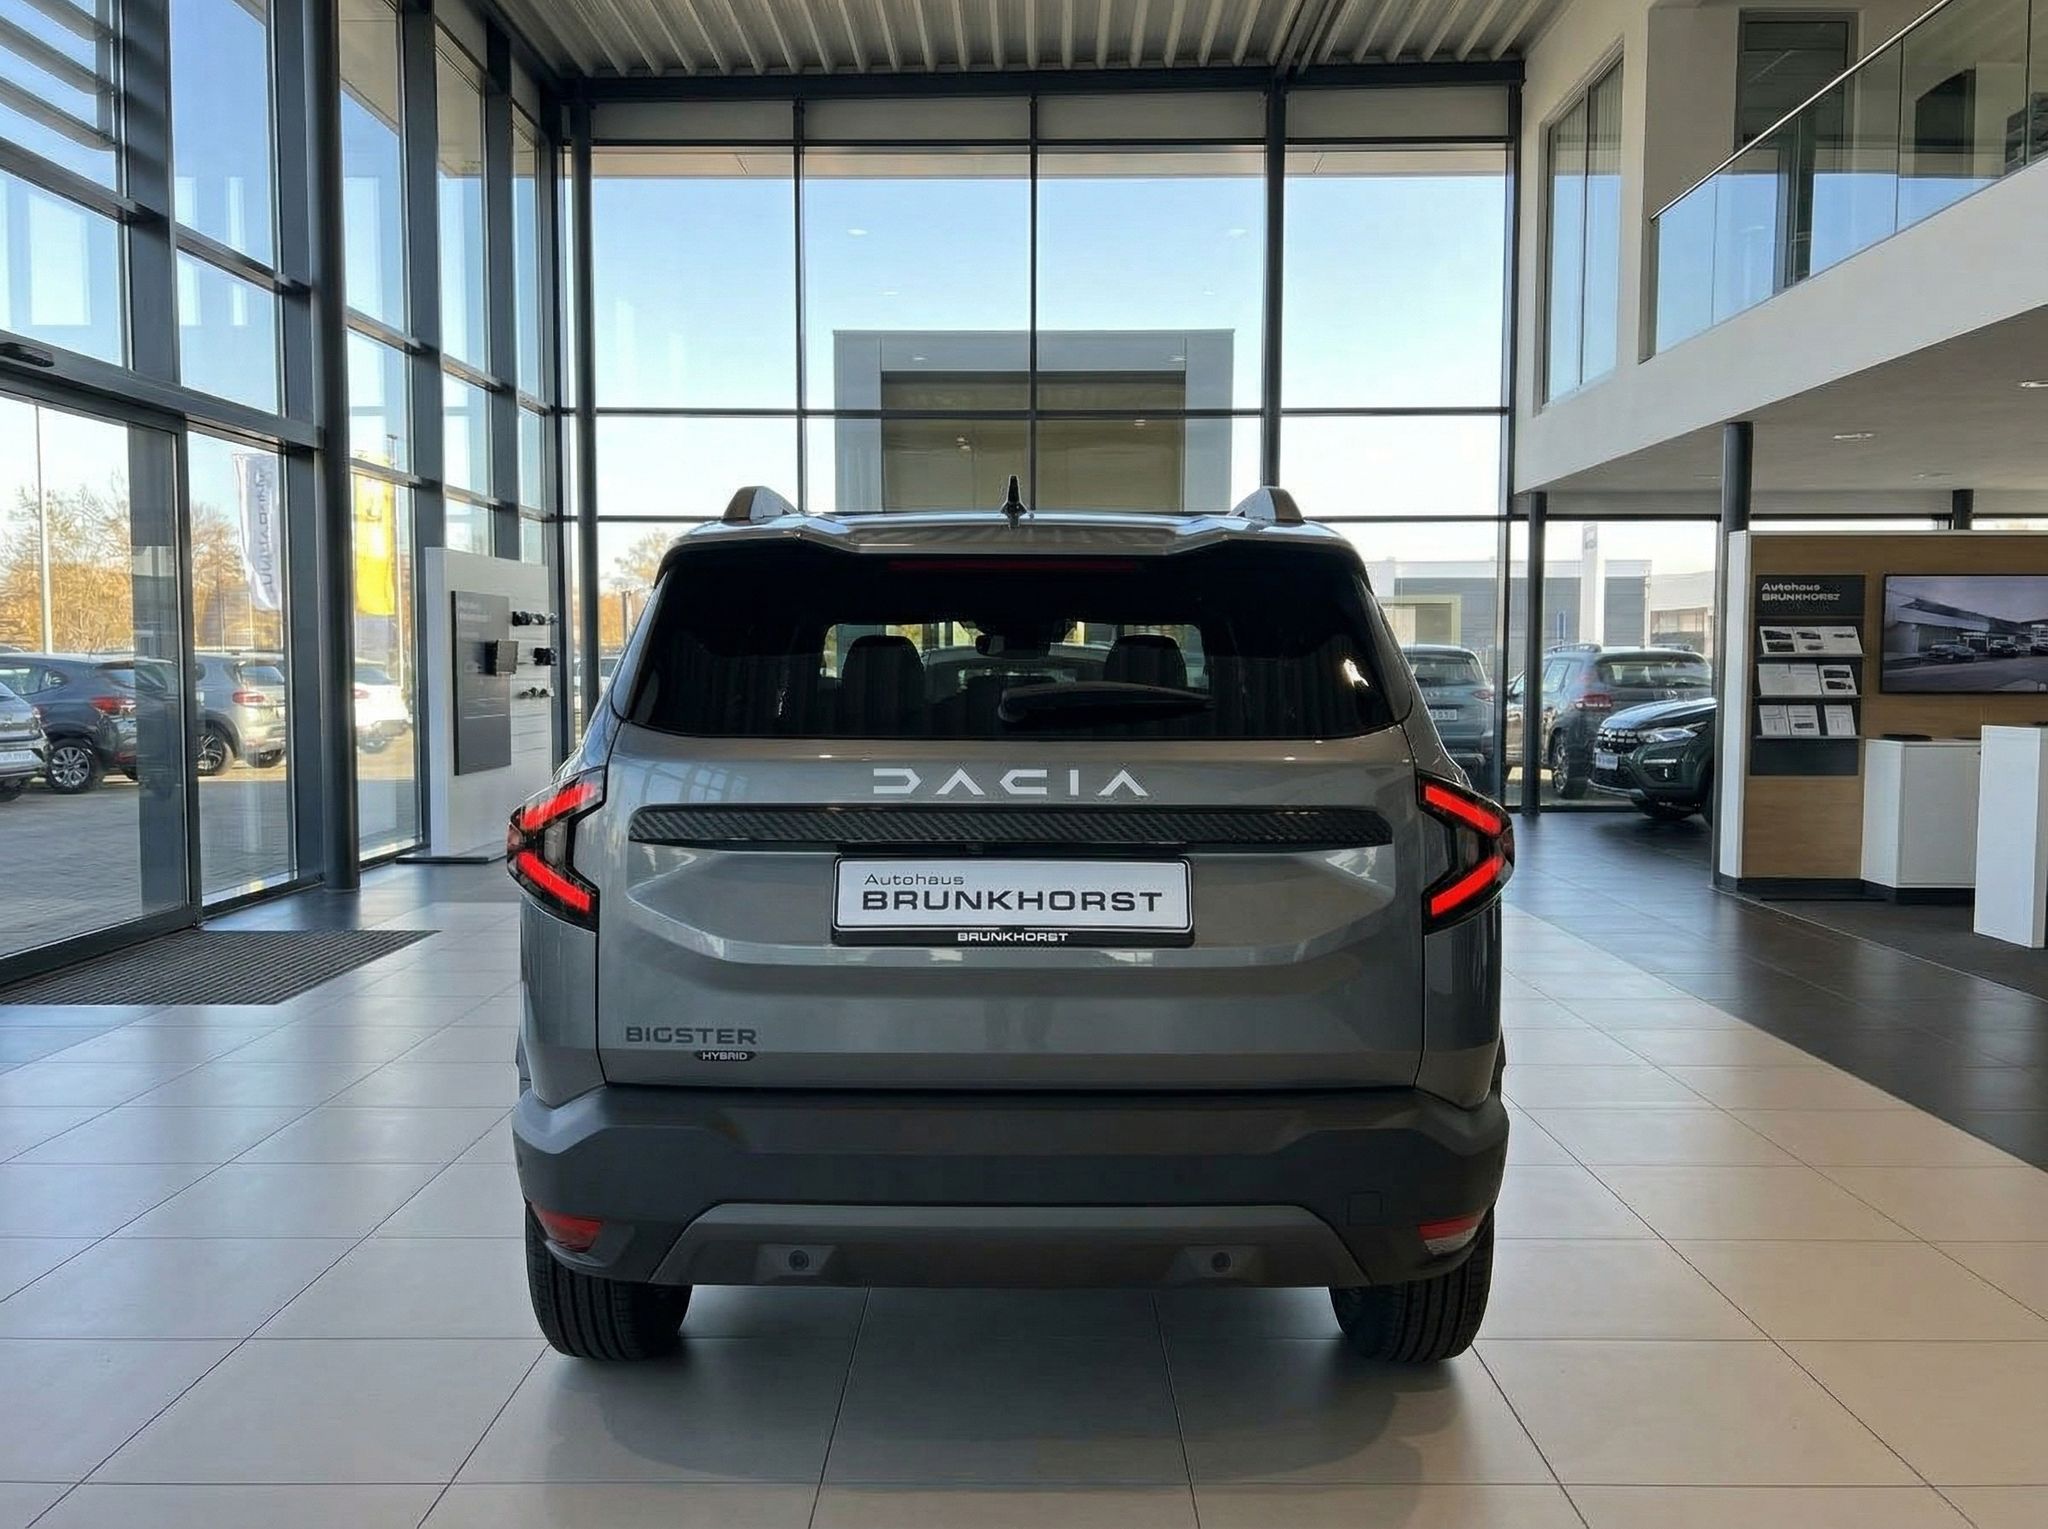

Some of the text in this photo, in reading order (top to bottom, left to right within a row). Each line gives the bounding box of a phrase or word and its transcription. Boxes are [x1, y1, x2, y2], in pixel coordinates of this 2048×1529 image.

[1761, 583, 1820, 591] Autohaus
[873, 768, 1149, 796] DACIA
[864, 873, 965, 886] Autohaus
[862, 890, 1163, 912] BRUNKHORST
[957, 932, 1068, 942] BRUNKHORST
[625, 1026, 757, 1045] BIGSTER
[702, 1051, 748, 1061] HYBRID
